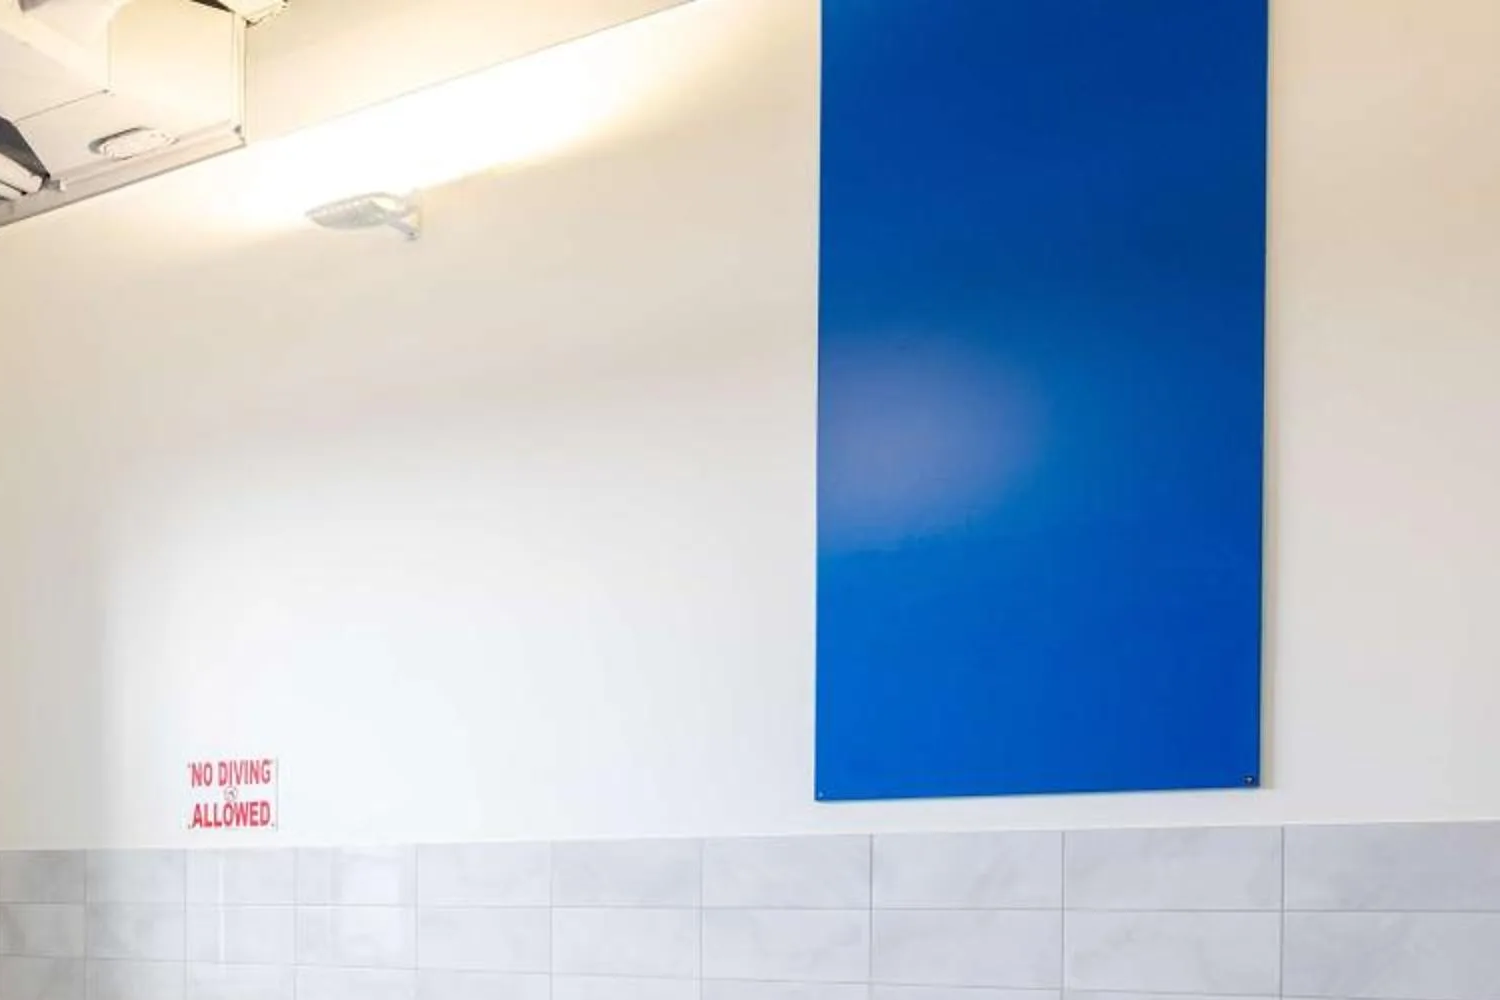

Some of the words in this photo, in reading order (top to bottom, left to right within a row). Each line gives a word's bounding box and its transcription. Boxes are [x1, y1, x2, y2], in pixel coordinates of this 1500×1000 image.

[191, 761, 213, 789] NO
[217, 758, 271, 787] DIVING
[192, 800, 271, 829] ALLOWED
